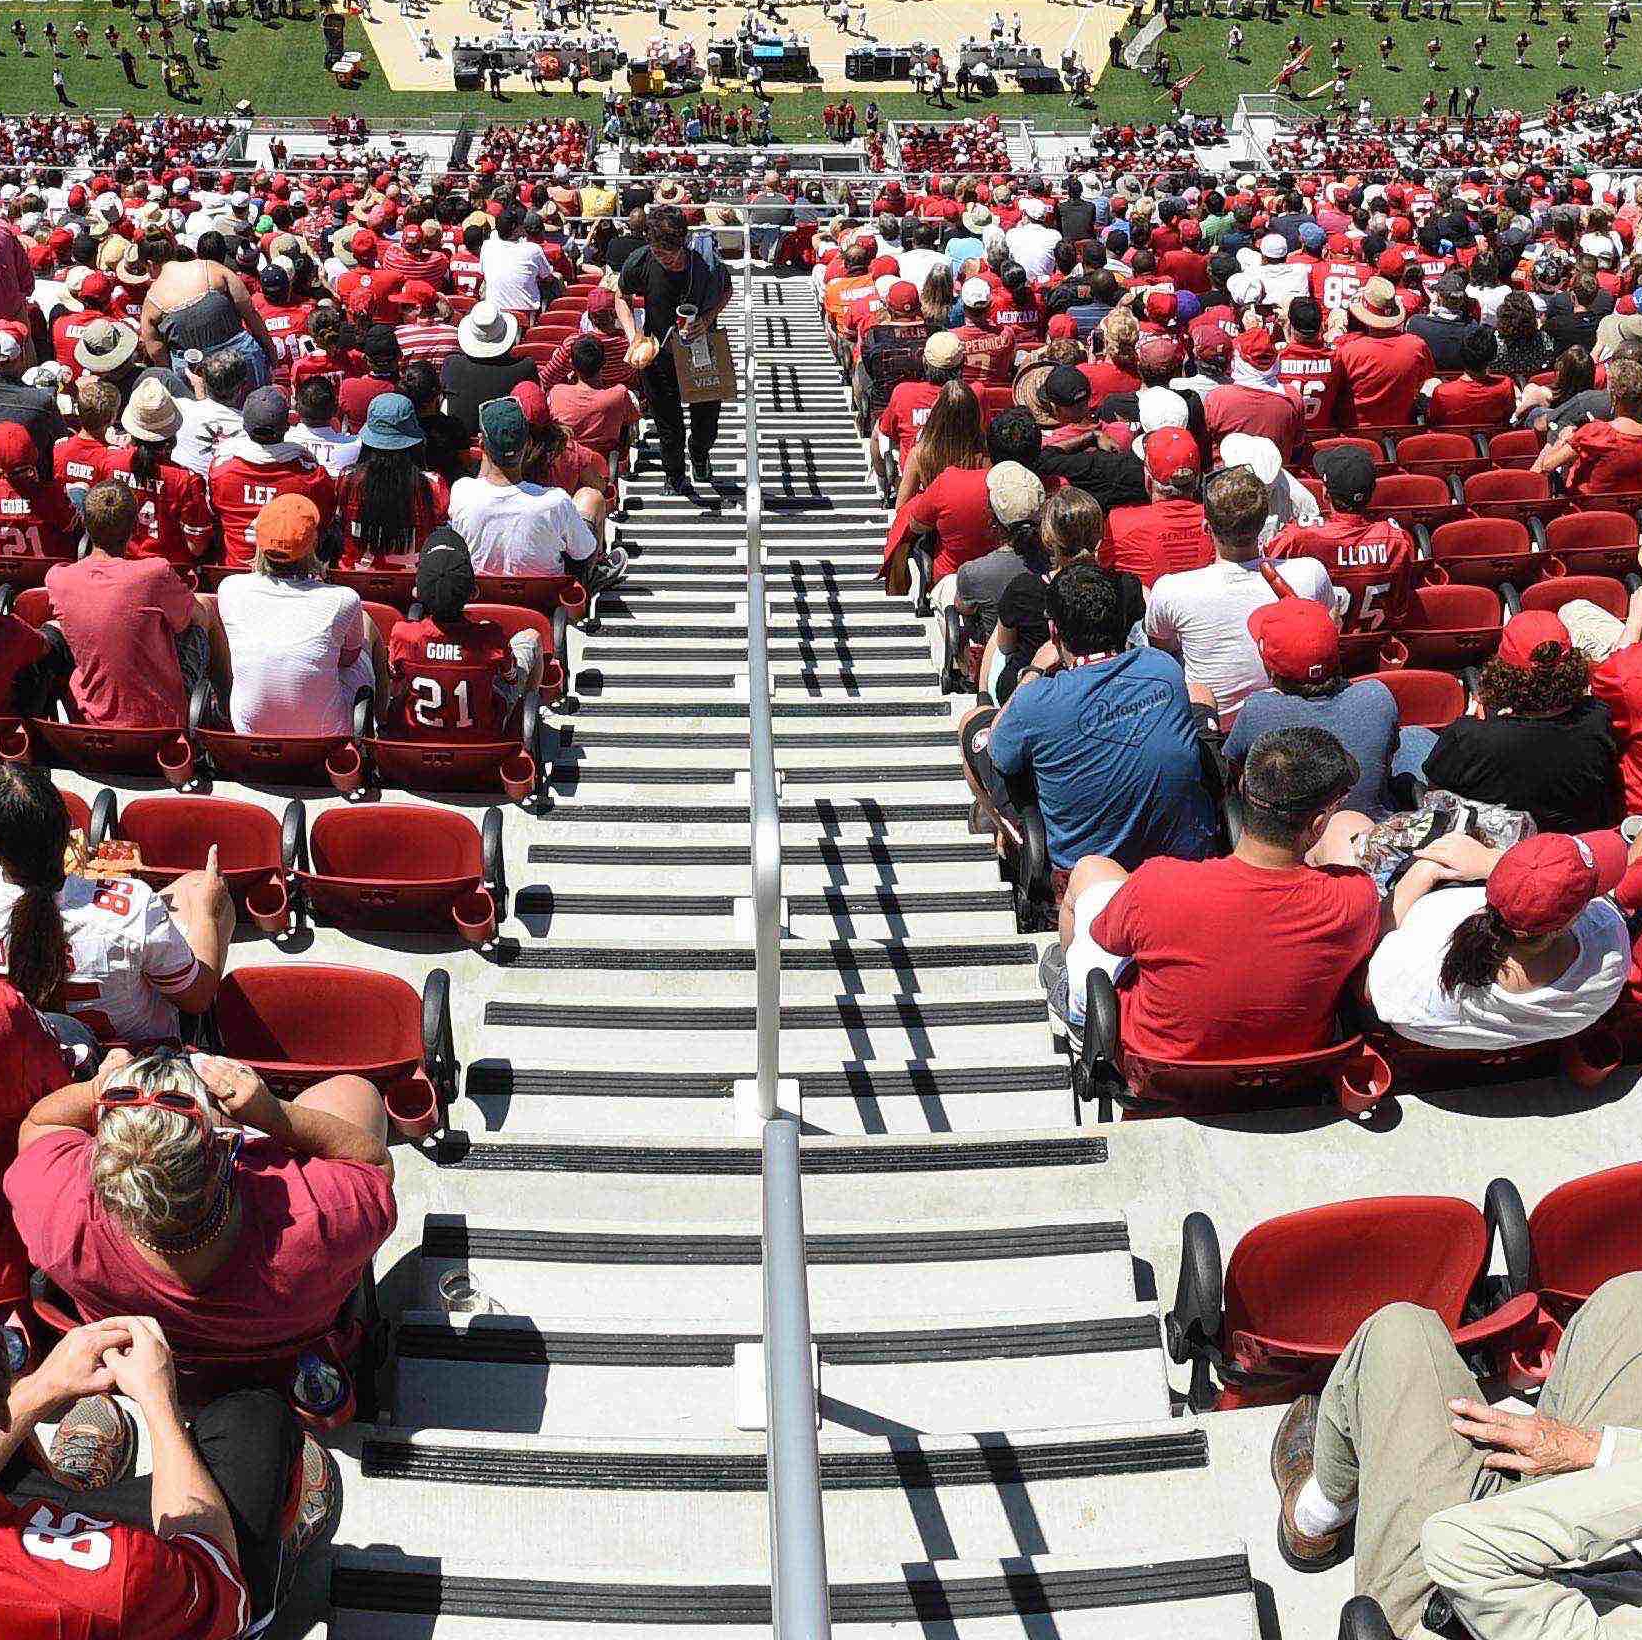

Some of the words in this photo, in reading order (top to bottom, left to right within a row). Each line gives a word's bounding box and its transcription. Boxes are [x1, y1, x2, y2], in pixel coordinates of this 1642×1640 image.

[1278, 358, 1333, 377] MONTANA
[691, 373, 722, 388] VISA
[1338, 545, 1388, 568] LLOYD
[427, 642, 463, 661] GORE
[412, 676, 470, 728] 21
